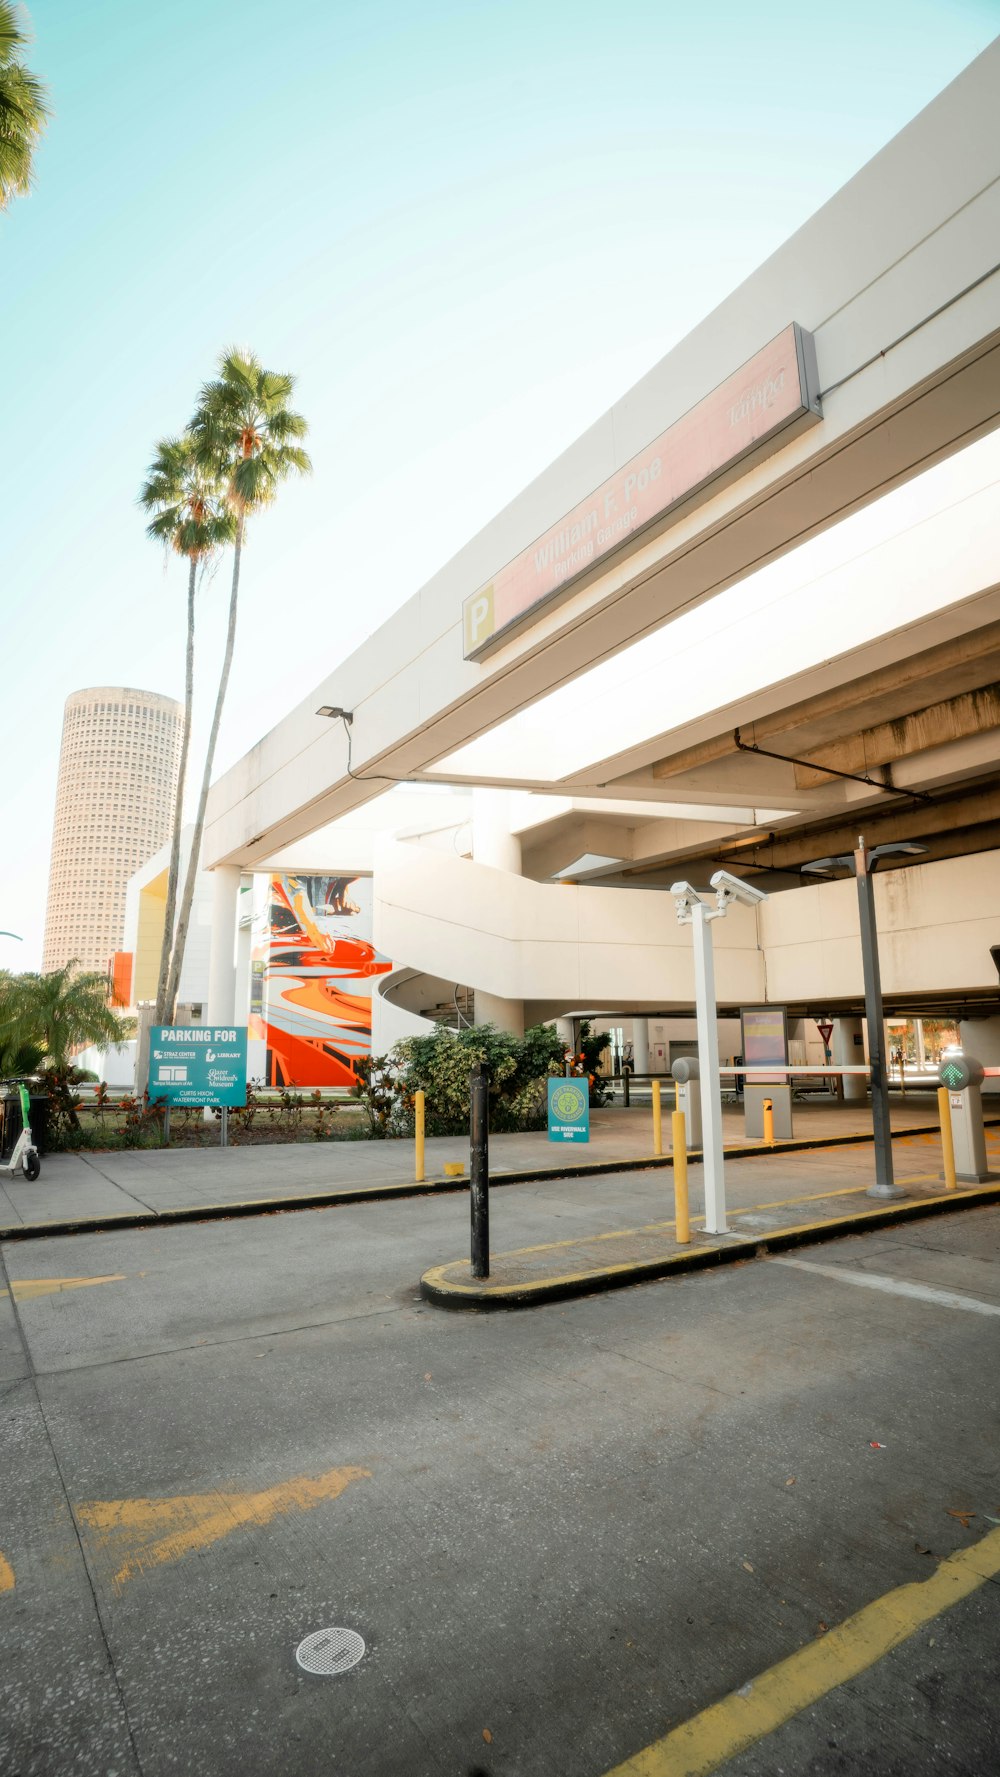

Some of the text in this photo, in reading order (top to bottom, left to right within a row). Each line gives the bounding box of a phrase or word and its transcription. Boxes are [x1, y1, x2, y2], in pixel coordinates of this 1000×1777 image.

[533, 457, 662, 575] William F. Poe
[553, 506, 638, 577] Parking Garage
[471, 596, 489, 643] P
[161, 1030, 237, 1042] PARKING FOR
